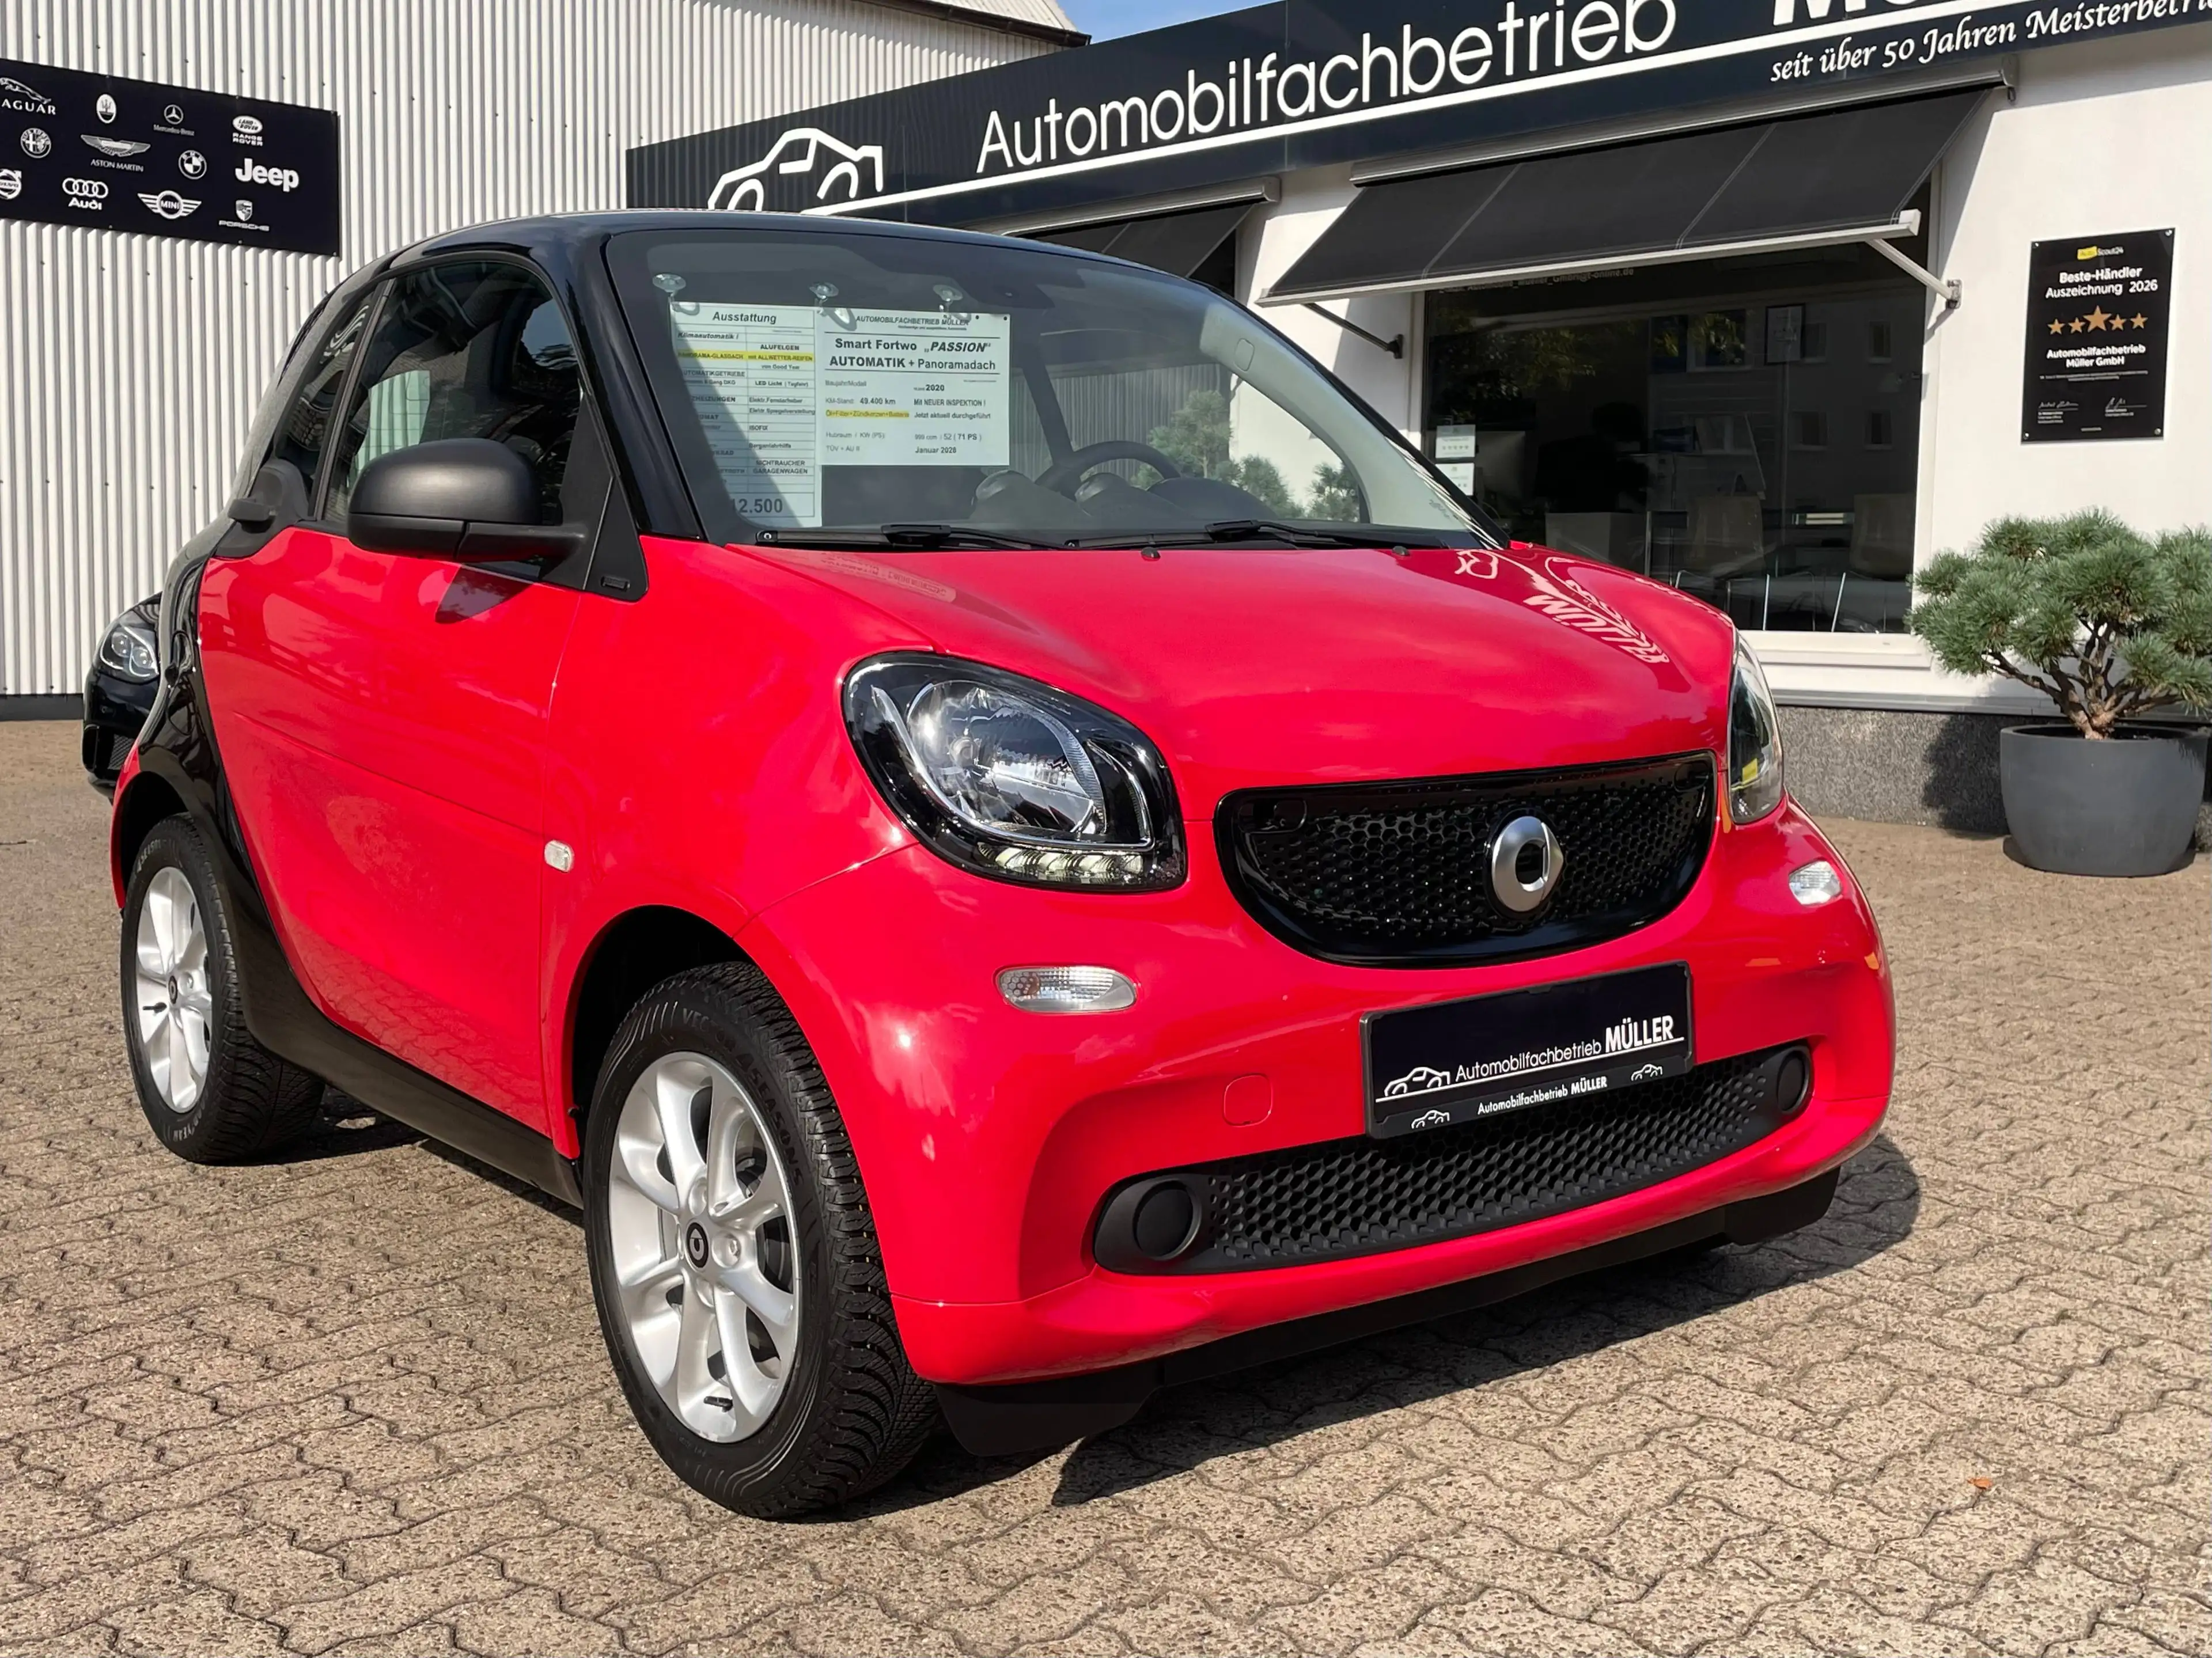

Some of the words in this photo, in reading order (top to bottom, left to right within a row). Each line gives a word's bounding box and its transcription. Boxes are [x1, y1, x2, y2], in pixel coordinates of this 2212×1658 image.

[1770, 51, 1812, 82] seit
[1820, 37, 1876, 71] über
[1882, 40, 1915, 68] 50
[1918, 16, 2017, 65] Jahren
[976, 0, 1676, 173] Automobilfachbetrieb
[1, 98, 56, 115] AGUAR
[233, 132, 262, 142] RANGE
[233, 138, 263, 146] ROVER
[90, 158, 115, 168] ASTON
[116, 162, 144, 172] MARTIN
[235, 158, 300, 192] Jeep
[68, 197, 103, 210] Audi
[161, 200, 180, 210] MINI
[219, 220, 270, 232] PORSCHE
[2059, 267, 2143, 284] Beste-Händler
[2046, 283, 2123, 299] Auszeichnung
[2128, 279, 2158, 293] 2026
[712, 312, 777, 324] Ausstattung
[855, 316, 940, 325] AUTOMOBILFACHBETRIEB
[941, 317, 970, 326] MÜLLER
[835, 338, 872, 350] Smart
[876, 340, 917, 351] Fortwo
[2046, 344, 2146, 359] Automobilfachbetrieb
[829, 356, 906, 368] AUTOMATIK
[918, 359, 996, 370] Panoramadach
[2066, 358, 2095, 368] Müller
[2095, 356, 2125, 367] GmbH
[1455, 1038, 1601, 1083] Automobilfachbetrieb
[1605, 1014, 1674, 1053] MÜLLER
[1477, 1086, 1568, 1116] Automobilfachbetrieb
[1570, 1075, 1607, 1095] MÜLLER
